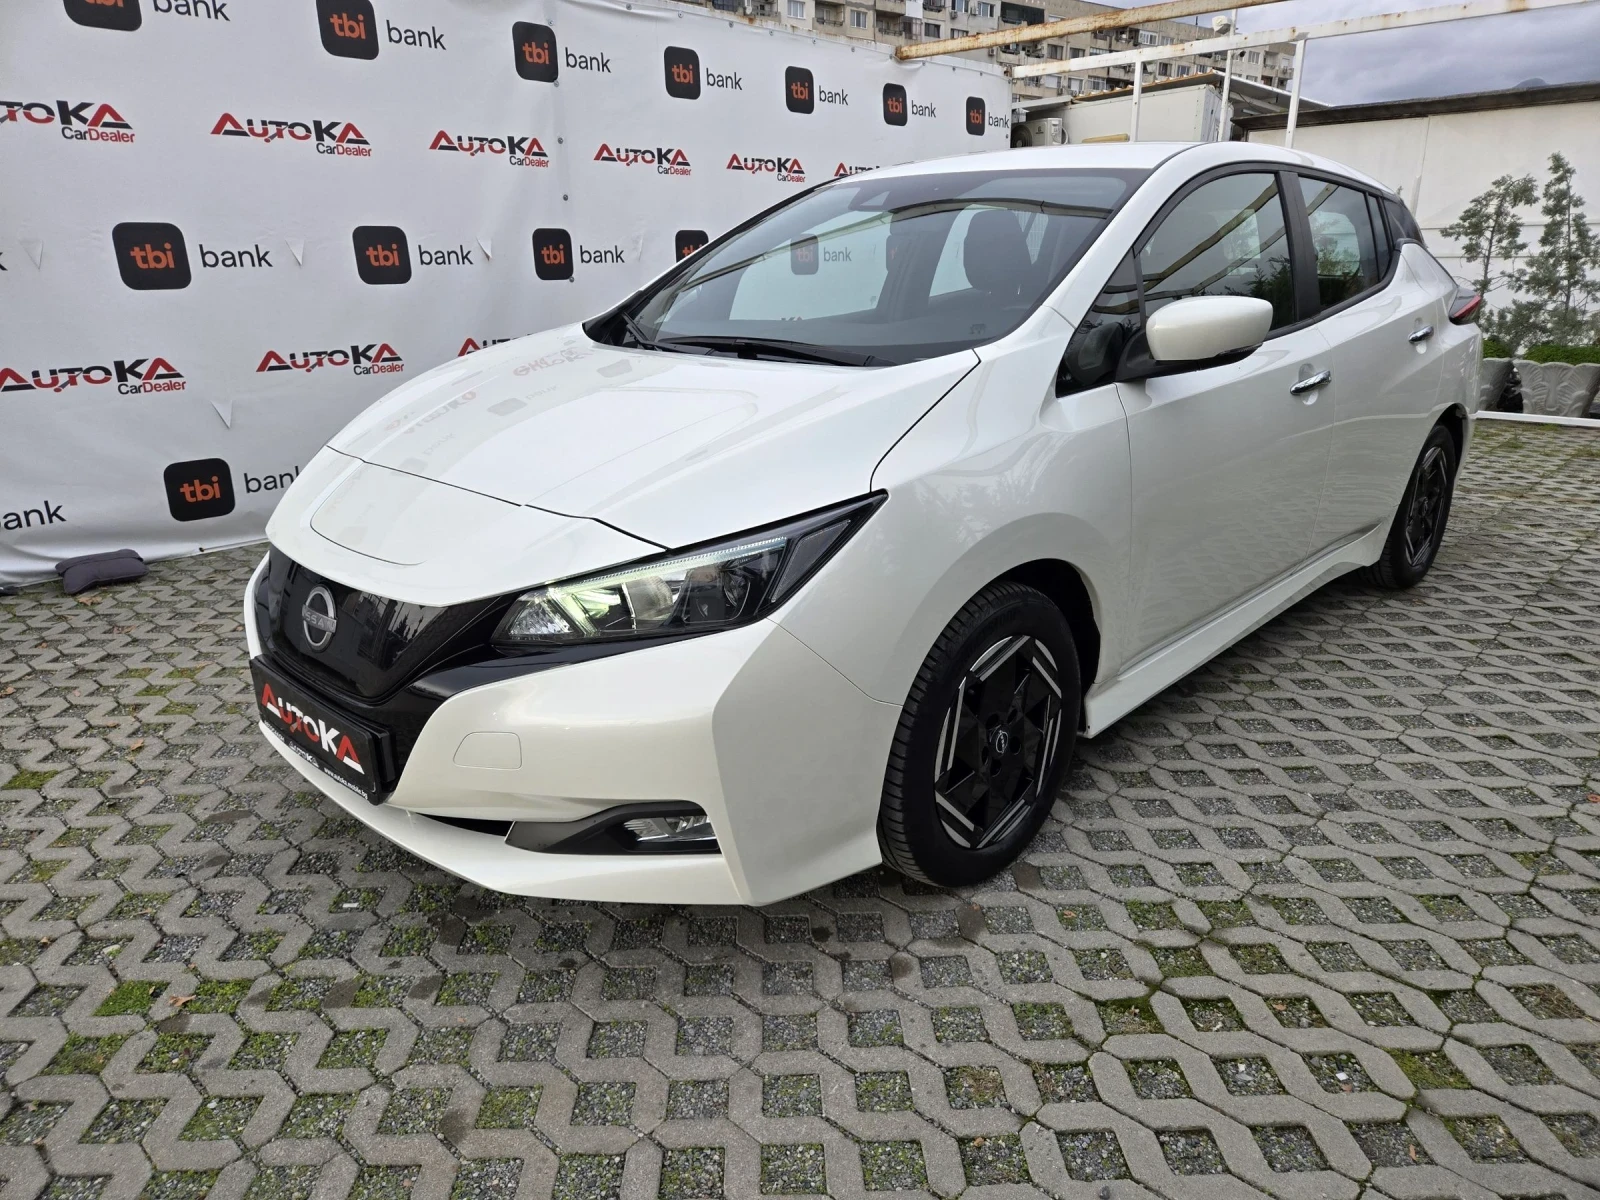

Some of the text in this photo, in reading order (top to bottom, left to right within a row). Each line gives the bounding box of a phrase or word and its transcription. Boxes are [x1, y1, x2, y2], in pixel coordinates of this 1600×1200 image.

[330, 13, 447, 50] tbi bank
[522, 42, 612, 73] tbi bank
[671, 64, 743, 91] tbi bank
[791, 82, 849, 106] tbi bank
[0, 100, 133, 130] TOKA
[887, 98, 937, 118] tbi bank
[969, 110, 1010, 129] tbi bank
[61, 126, 135, 143] CarDealer
[210, 112, 371, 146] AUTOKA
[316, 142, 372, 157] CarDealer
[429, 130, 549, 158] AUTOKA
[593, 143, 691, 167] AUTOKA
[509, 155, 549, 168] CarDealer
[657, 165, 691, 176] CarDealer
[726, 153, 805, 175] AUTOKA
[776, 172, 806, 183] CarDealer
[130, 242, 273, 269] tbi bank
[366, 244, 473, 267] tbi bank
[541, 245, 625, 265] tbi bank
[823, 246, 852, 262] bank
[256, 343, 403, 373] AUTOKA
[353, 363, 404, 376] CarDealer
[117, 380, 187, 395] CarDealer
[180, 476, 221, 503] tbi
[0, 500, 67, 531] ank
[262, 683, 365, 775] AUTOKA
